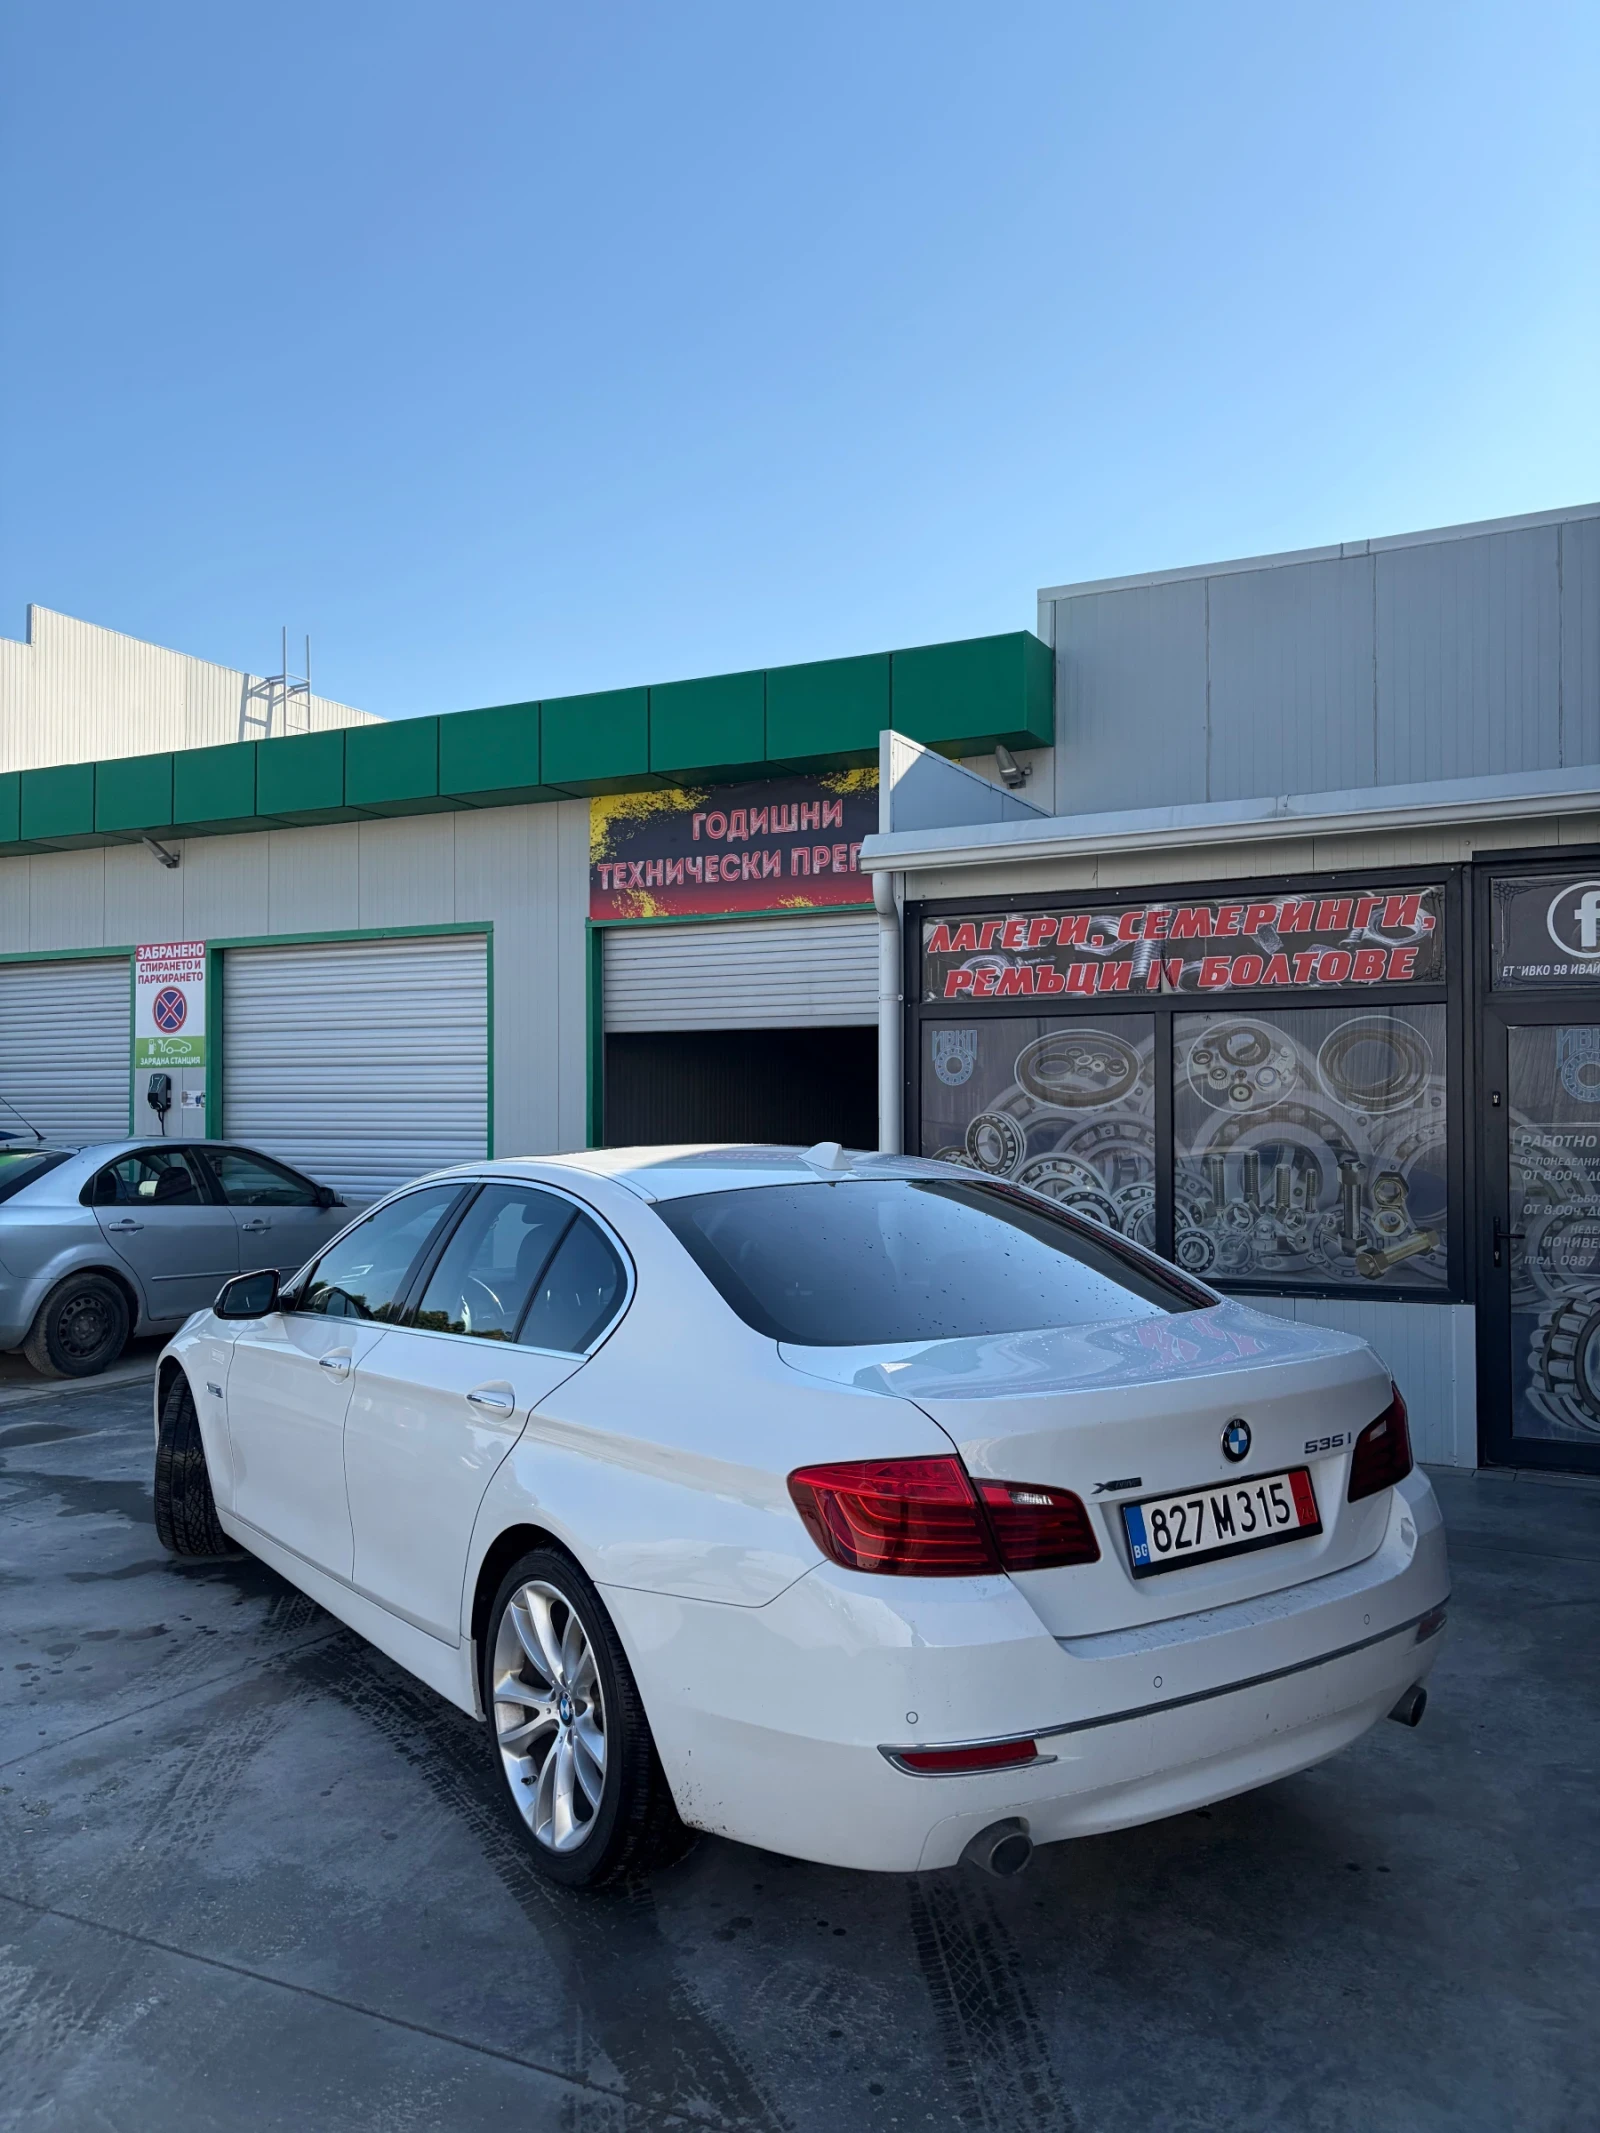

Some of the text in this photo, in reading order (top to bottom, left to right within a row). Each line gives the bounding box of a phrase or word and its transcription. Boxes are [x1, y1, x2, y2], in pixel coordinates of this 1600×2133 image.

[692, 799, 843, 842] ГОДИШНИ
[597, 849, 781, 890] ТЕХНИЧЕСКИ
[928, 894, 1436, 953] ЛАГЕРИ, СЕМЕРИНГИ,
[138, 943, 204, 960] ЗАБРАНЕНО
[140, 960, 201, 973] СПИРАНЕТО И
[944, 961, 1133, 997] РЕМЪЦИ
[1198, 947, 1419, 987] БОЛТОВЕ
[1503, 966, 1515, 976] ЕТ
[1554, 965, 1567, 975] 98
[138, 971, 203, 984] ПАРКИРАНЕТО
[141, 1056, 200, 1066] ЗАРЯДНА СТАНЦИЯ
[1520, 1135, 1597, 1147] РАБОТНО
[1520, 1156, 1600, 1166] ОТ ПОНЕДЕЛНИ
[1523, 1169, 1540, 1180] ОТ
[1523, 1204, 1540, 1214] ОТ
[1543, 1236, 1600, 1249] ПОЧИВЕ
[1560, 1255, 1595, 1267] 0887
[1151, 1483, 1290, 1552] 827 M 315
[1134, 1544, 1148, 1558] BG
